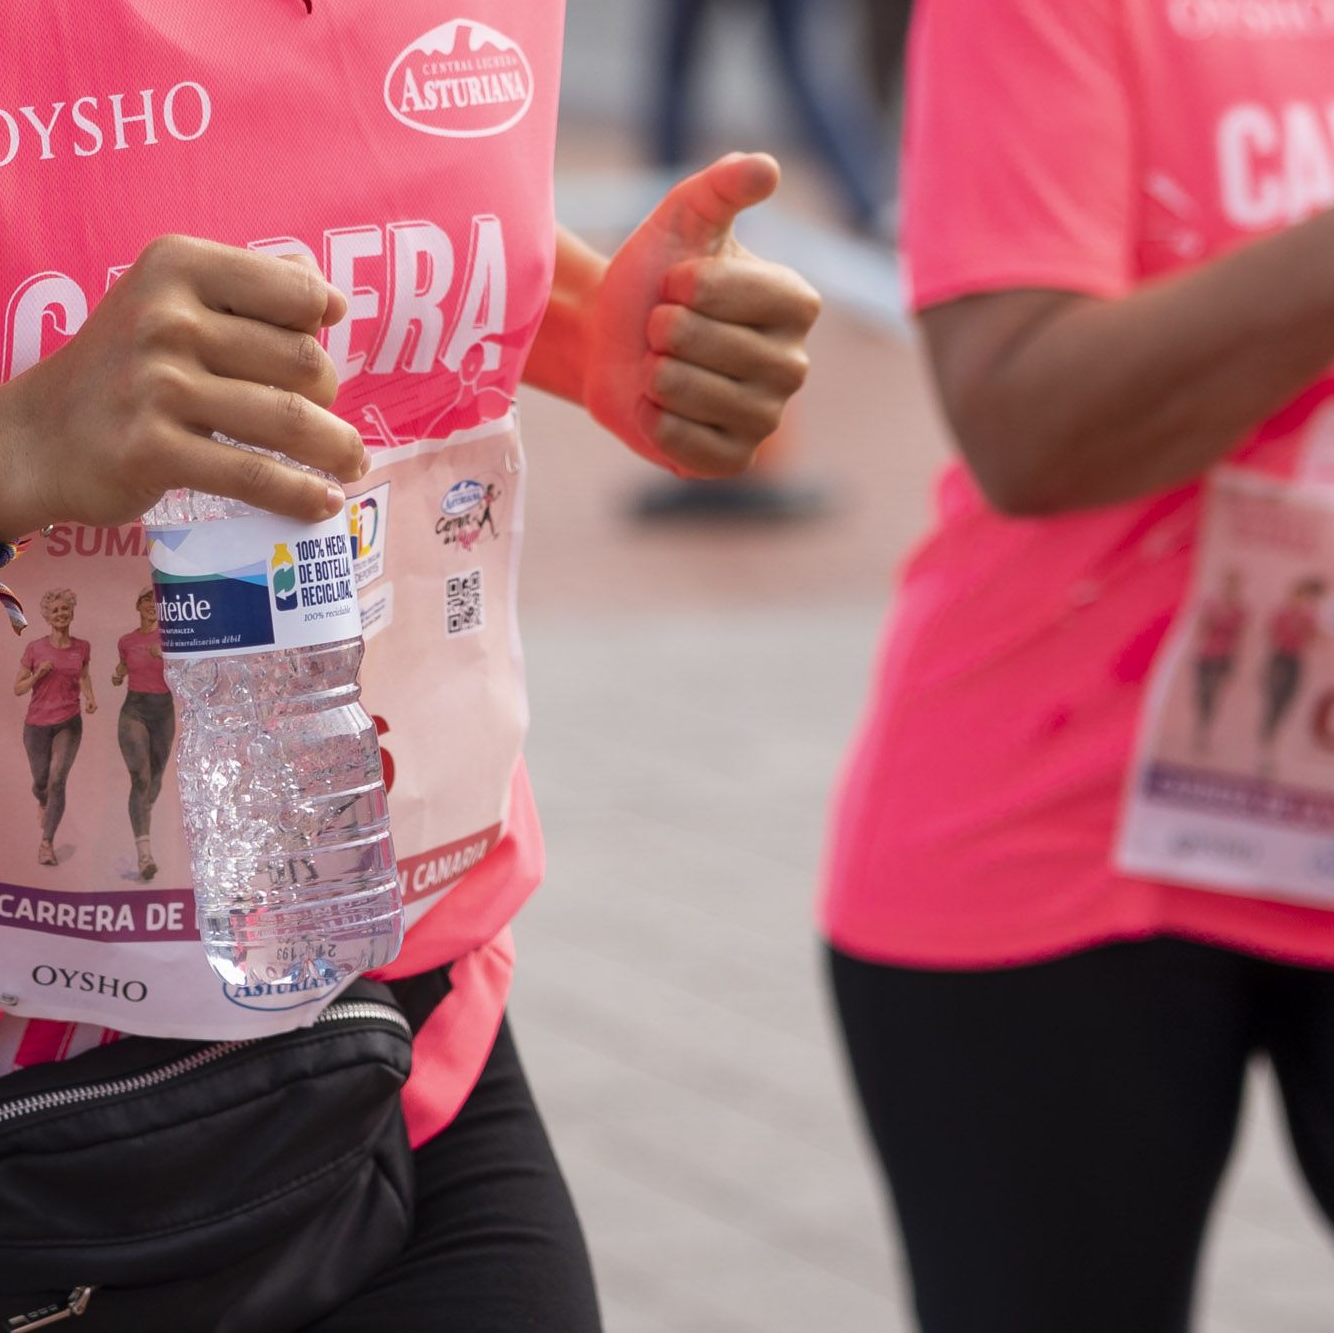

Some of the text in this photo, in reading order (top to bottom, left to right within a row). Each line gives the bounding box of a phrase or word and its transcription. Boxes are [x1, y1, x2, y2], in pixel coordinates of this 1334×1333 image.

[422, 59, 472, 75] CENTRAL
[399, 67, 527, 113] ASTURIANA
[2, 214, 508, 389] CERA
[47, 525, 150, 558] SUM
[296, 538, 325, 562] 100%
[299, 563, 314, 585] DE
[315, 557, 351, 582] BOTELLA
[304, 611, 325, 622] 100%
[221, 633, 241, 645] débil
[145, 902, 185, 932] DE
[31, 964, 148, 1003] OYSHO
